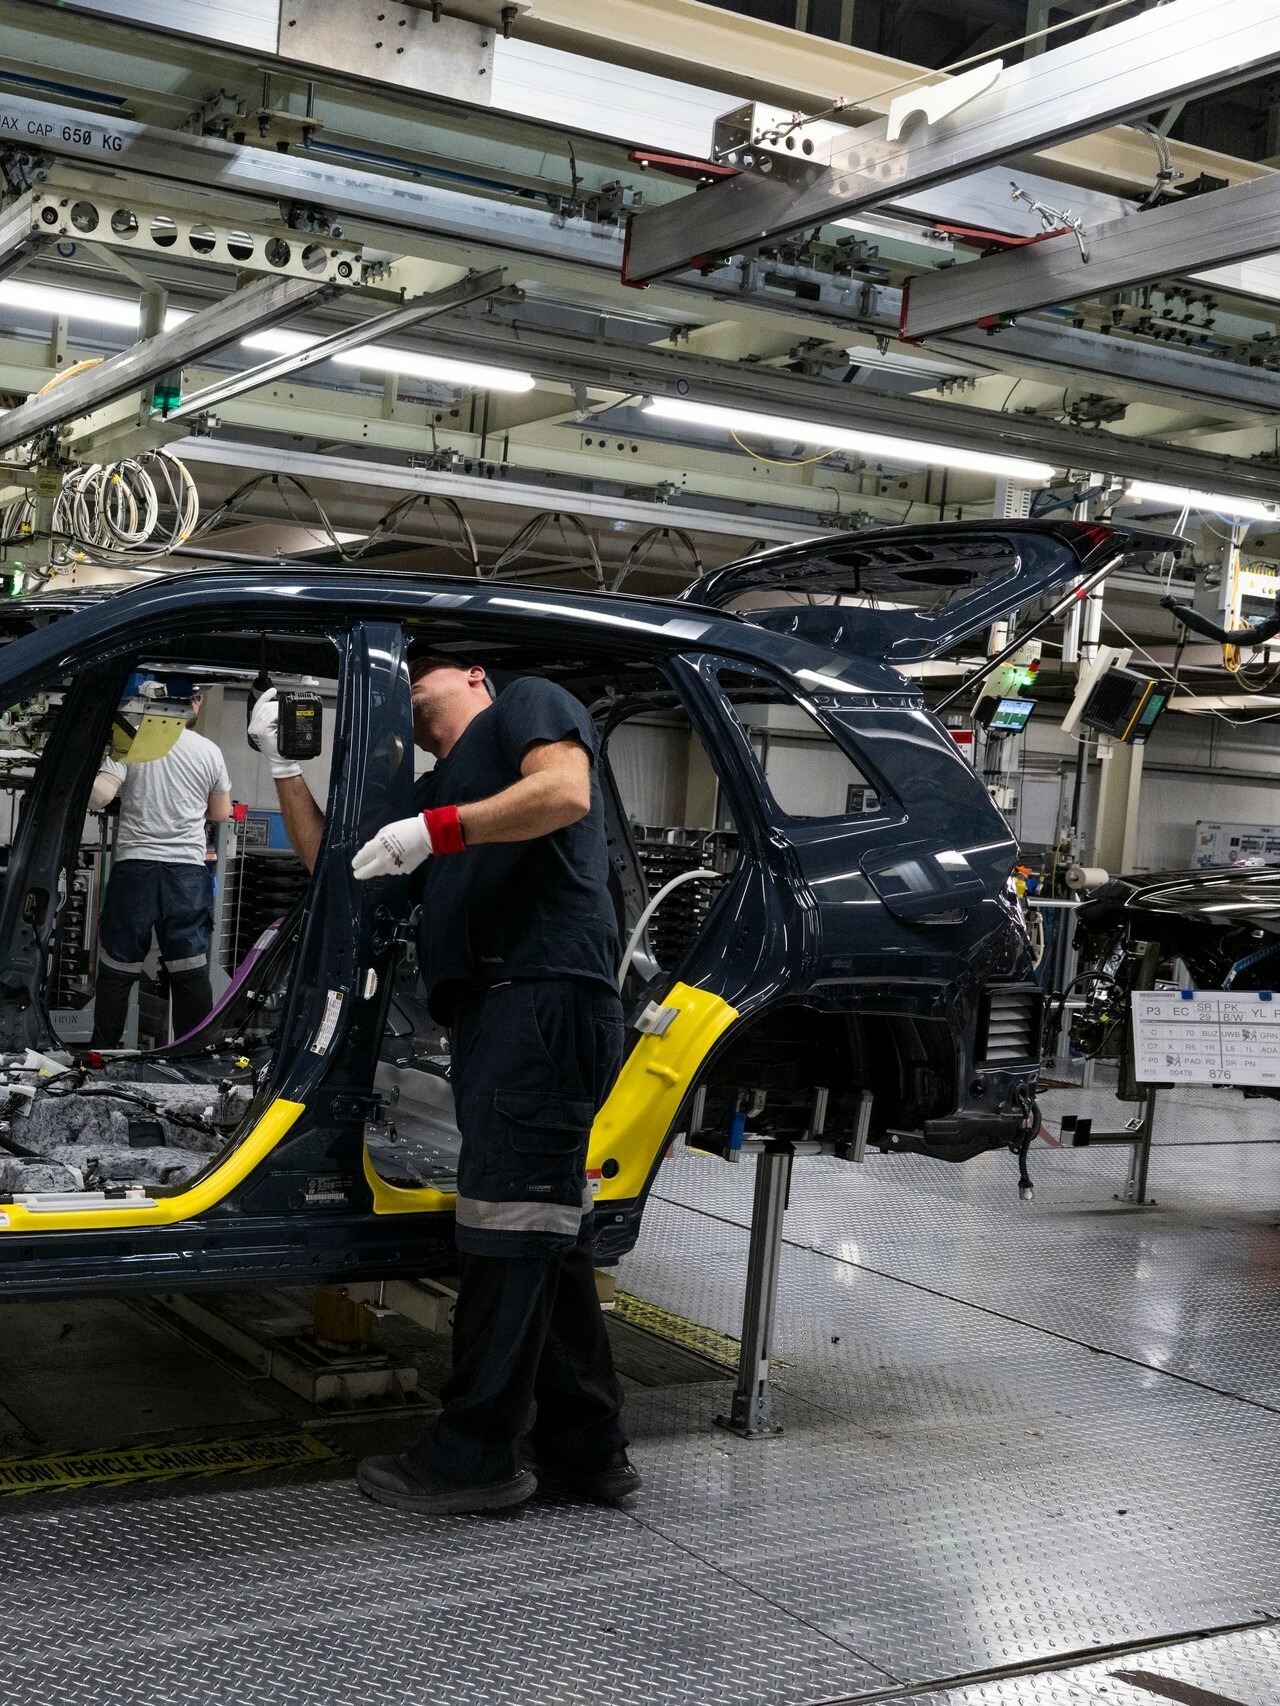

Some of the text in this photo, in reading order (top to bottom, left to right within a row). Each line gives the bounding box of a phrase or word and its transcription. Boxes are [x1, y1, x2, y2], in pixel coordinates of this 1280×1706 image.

[27, 121, 53, 137] CAP
[62, 126, 92, 145] 650
[102, 134, 122, 151] KG
[1146, 1007, 1190, 1016] P3 EC
[1197, 1003, 1212, 1011] SR
[1199, 1013, 1211, 1021] 29
[1223, 1014, 1244, 1022] B/W
[1251, 1009, 1266, 1018] YL
[1209, 1069, 1231, 1079] 876
[55, 1455, 149, 1479] VEHICLE
[143, 1447, 245, 1470] CHANGES
[243, 1439, 314, 1461] HEIGHT
